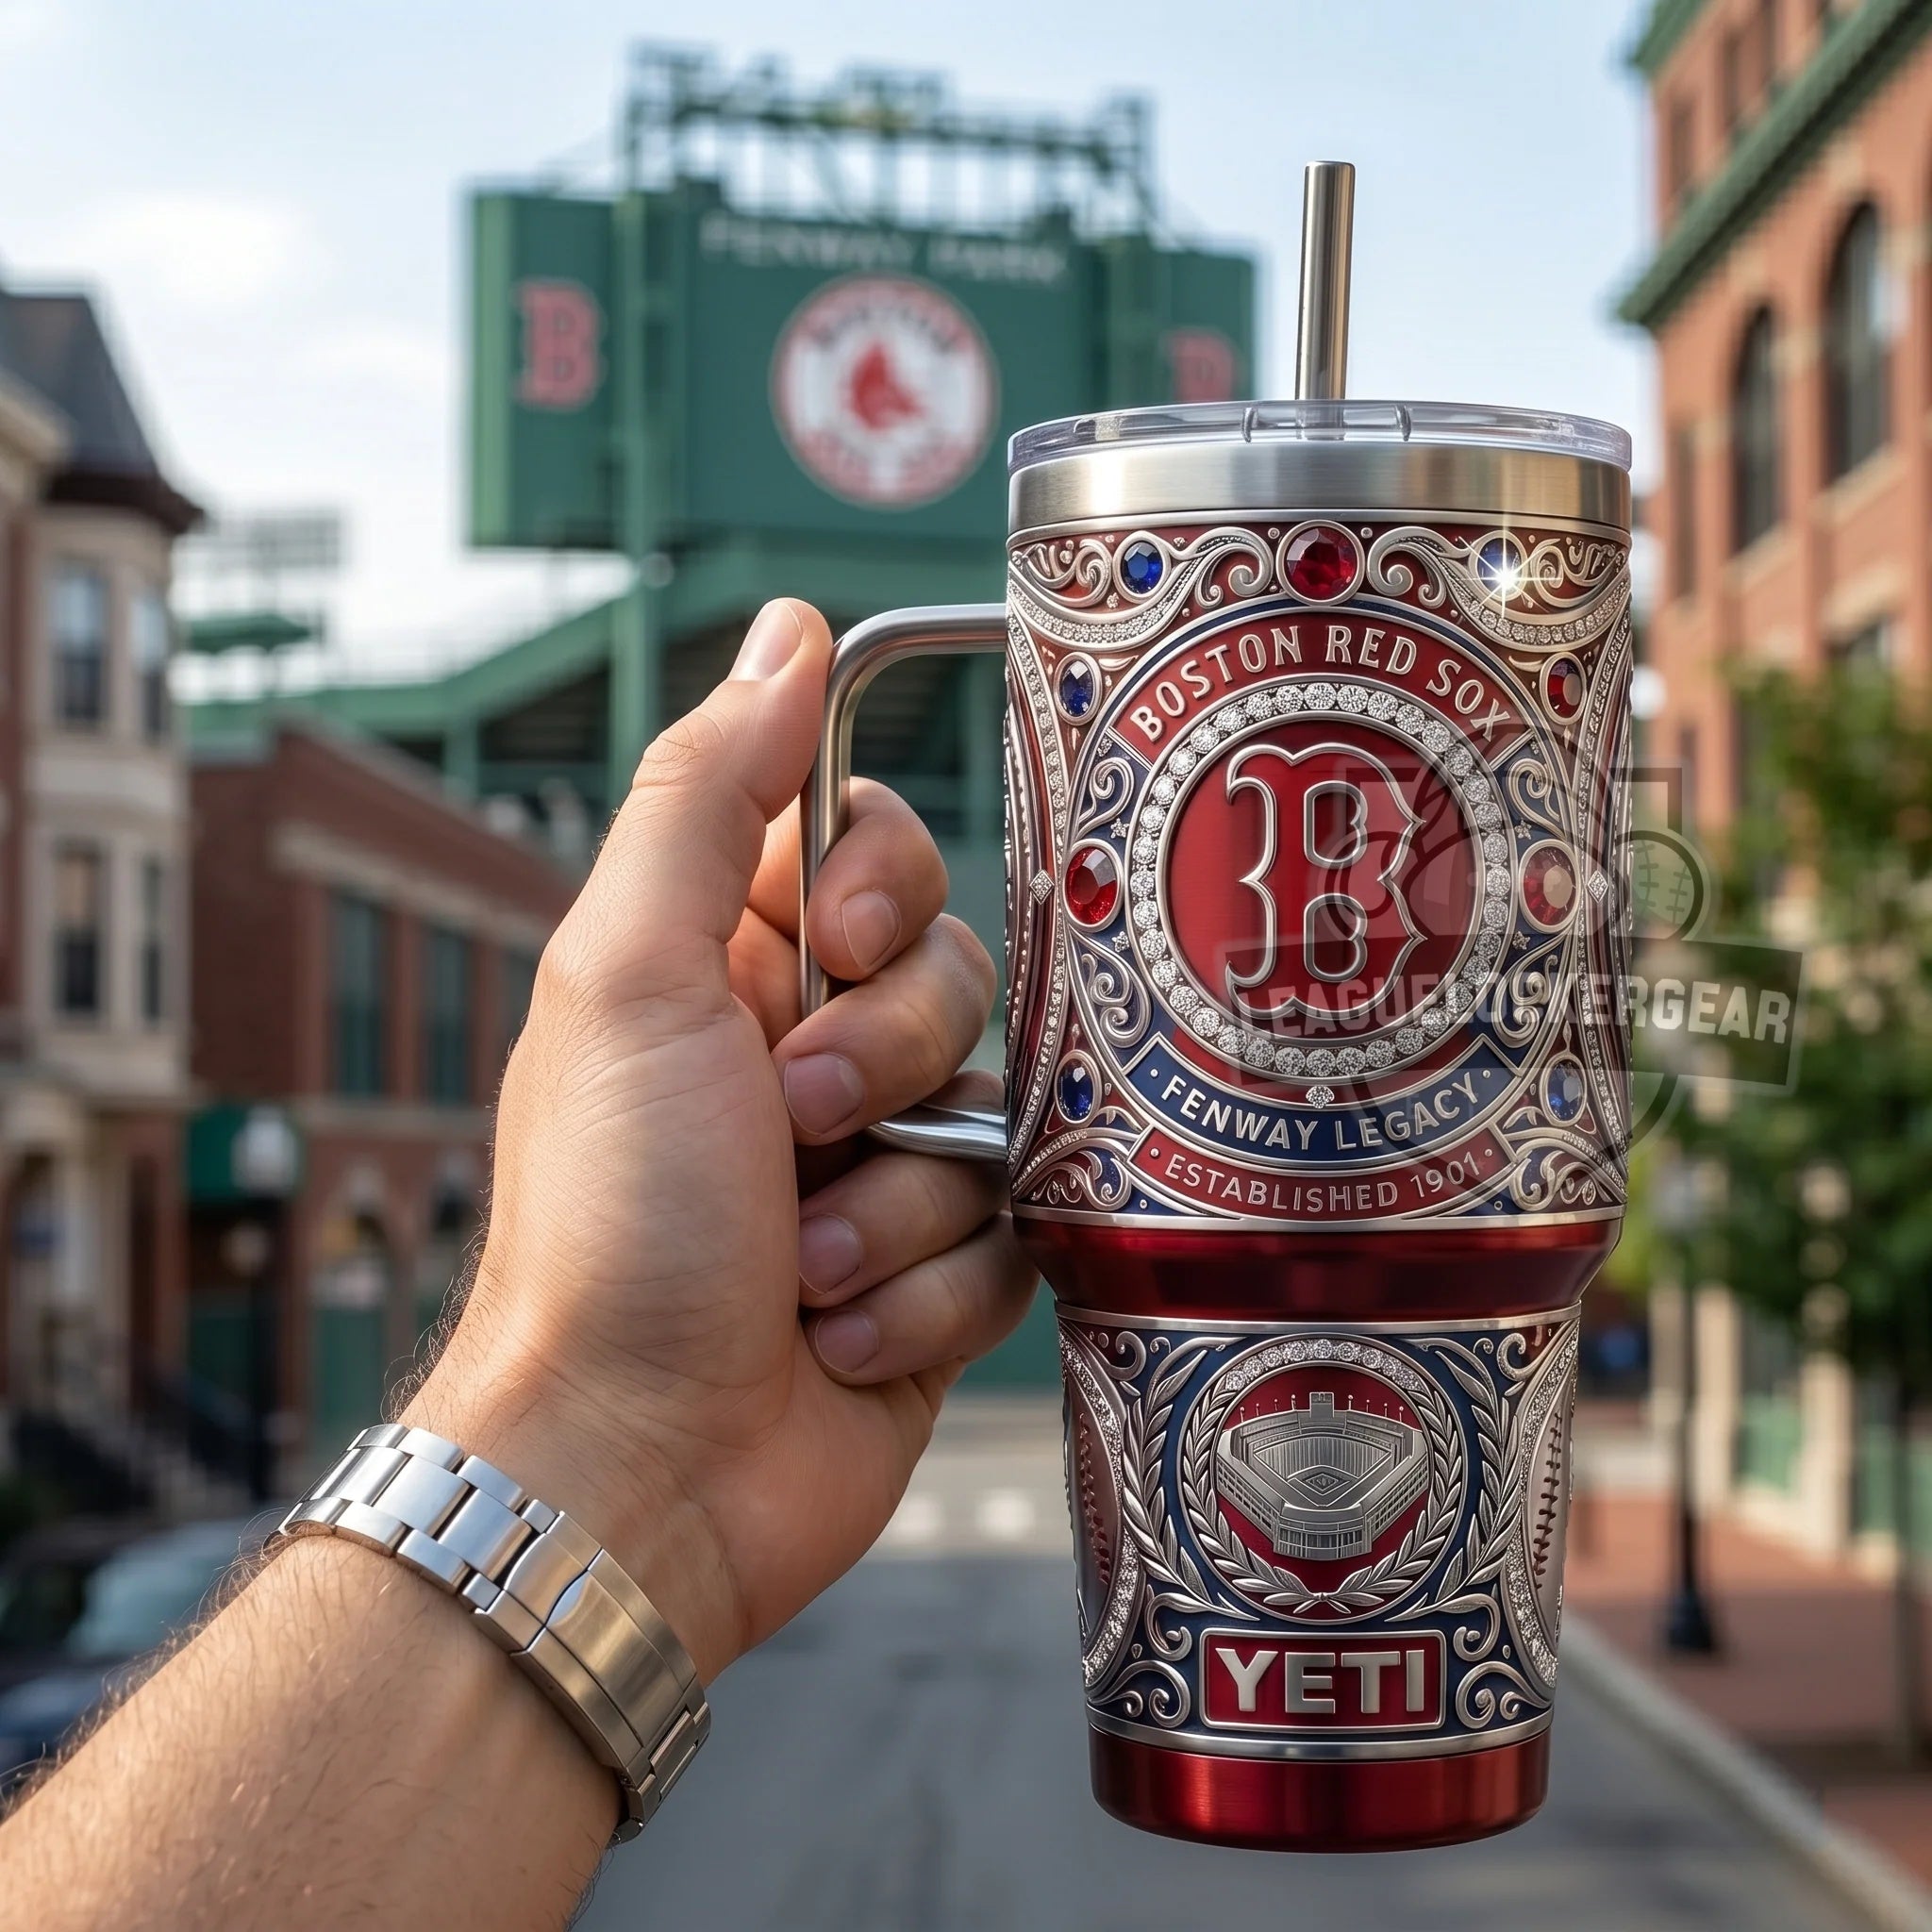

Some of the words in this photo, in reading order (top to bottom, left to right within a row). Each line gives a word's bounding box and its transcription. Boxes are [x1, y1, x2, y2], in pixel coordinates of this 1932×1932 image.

[1130, 625, 1303, 742] BOSTON
[1324, 625, 1417, 675] RED
[1425, 658, 1511, 742] SOX
[1161, 1074, 1320, 1151] FENWAY
[1335, 1071, 1478, 1151] LEGACY
[1164, 1153, 1399, 1213] ESTABLISHED
[1410, 1151, 1480, 1199] 1901
[1215, 1647, 1425, 1715] YETI
